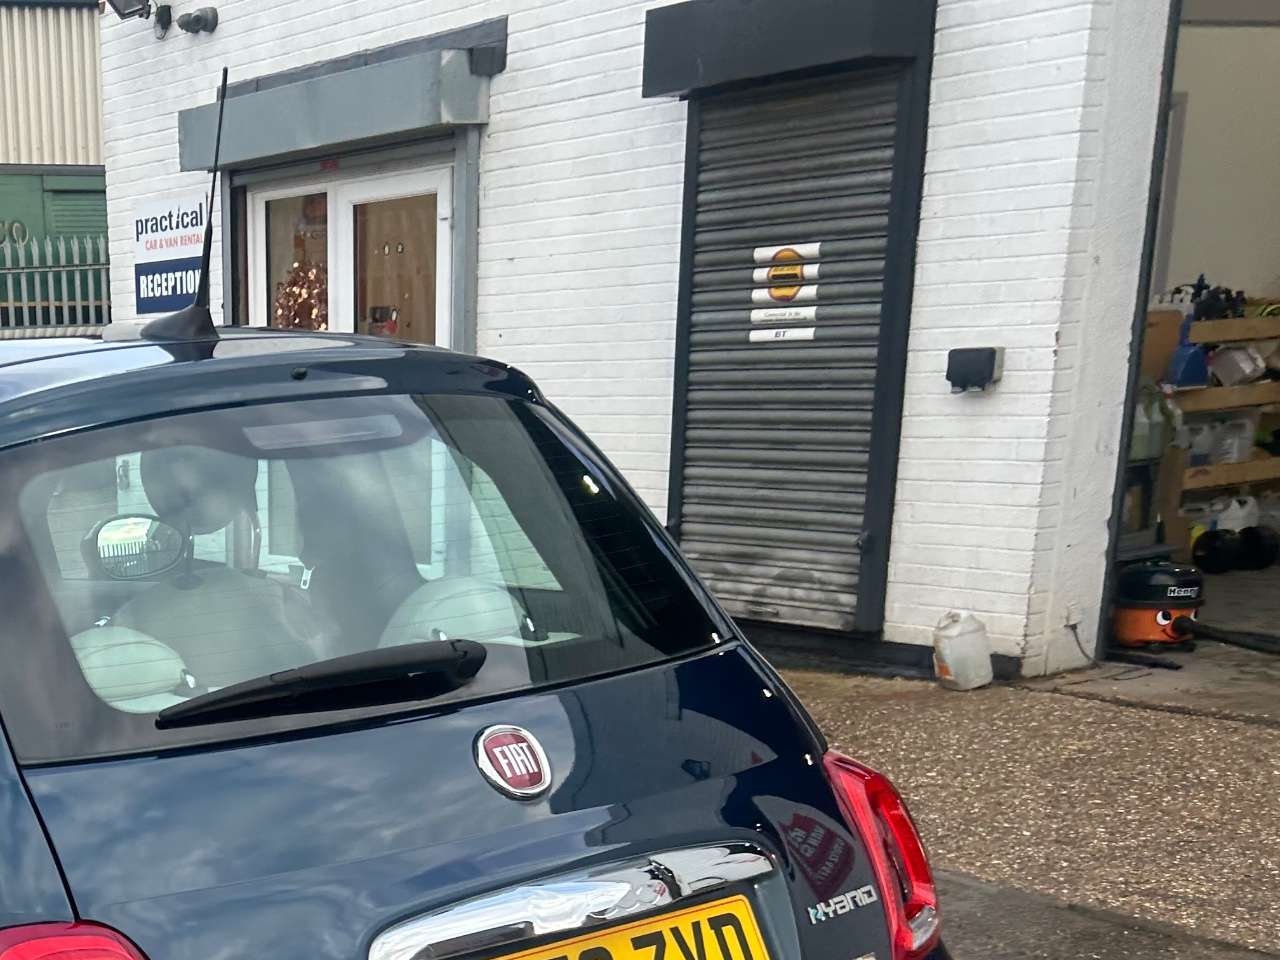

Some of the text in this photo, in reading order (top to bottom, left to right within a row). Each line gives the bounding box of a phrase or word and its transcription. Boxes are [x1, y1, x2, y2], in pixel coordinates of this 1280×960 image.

[135, 202, 203, 242] practical
[145, 239, 158, 251] CAR
[164, 236, 180, 248] VAN
[180, 233, 204, 246] RENTAL
[139, 268, 202, 299] RECEPTION
[492, 742, 539, 778] FIAT
[807, 884, 878, 925] HYBRID
